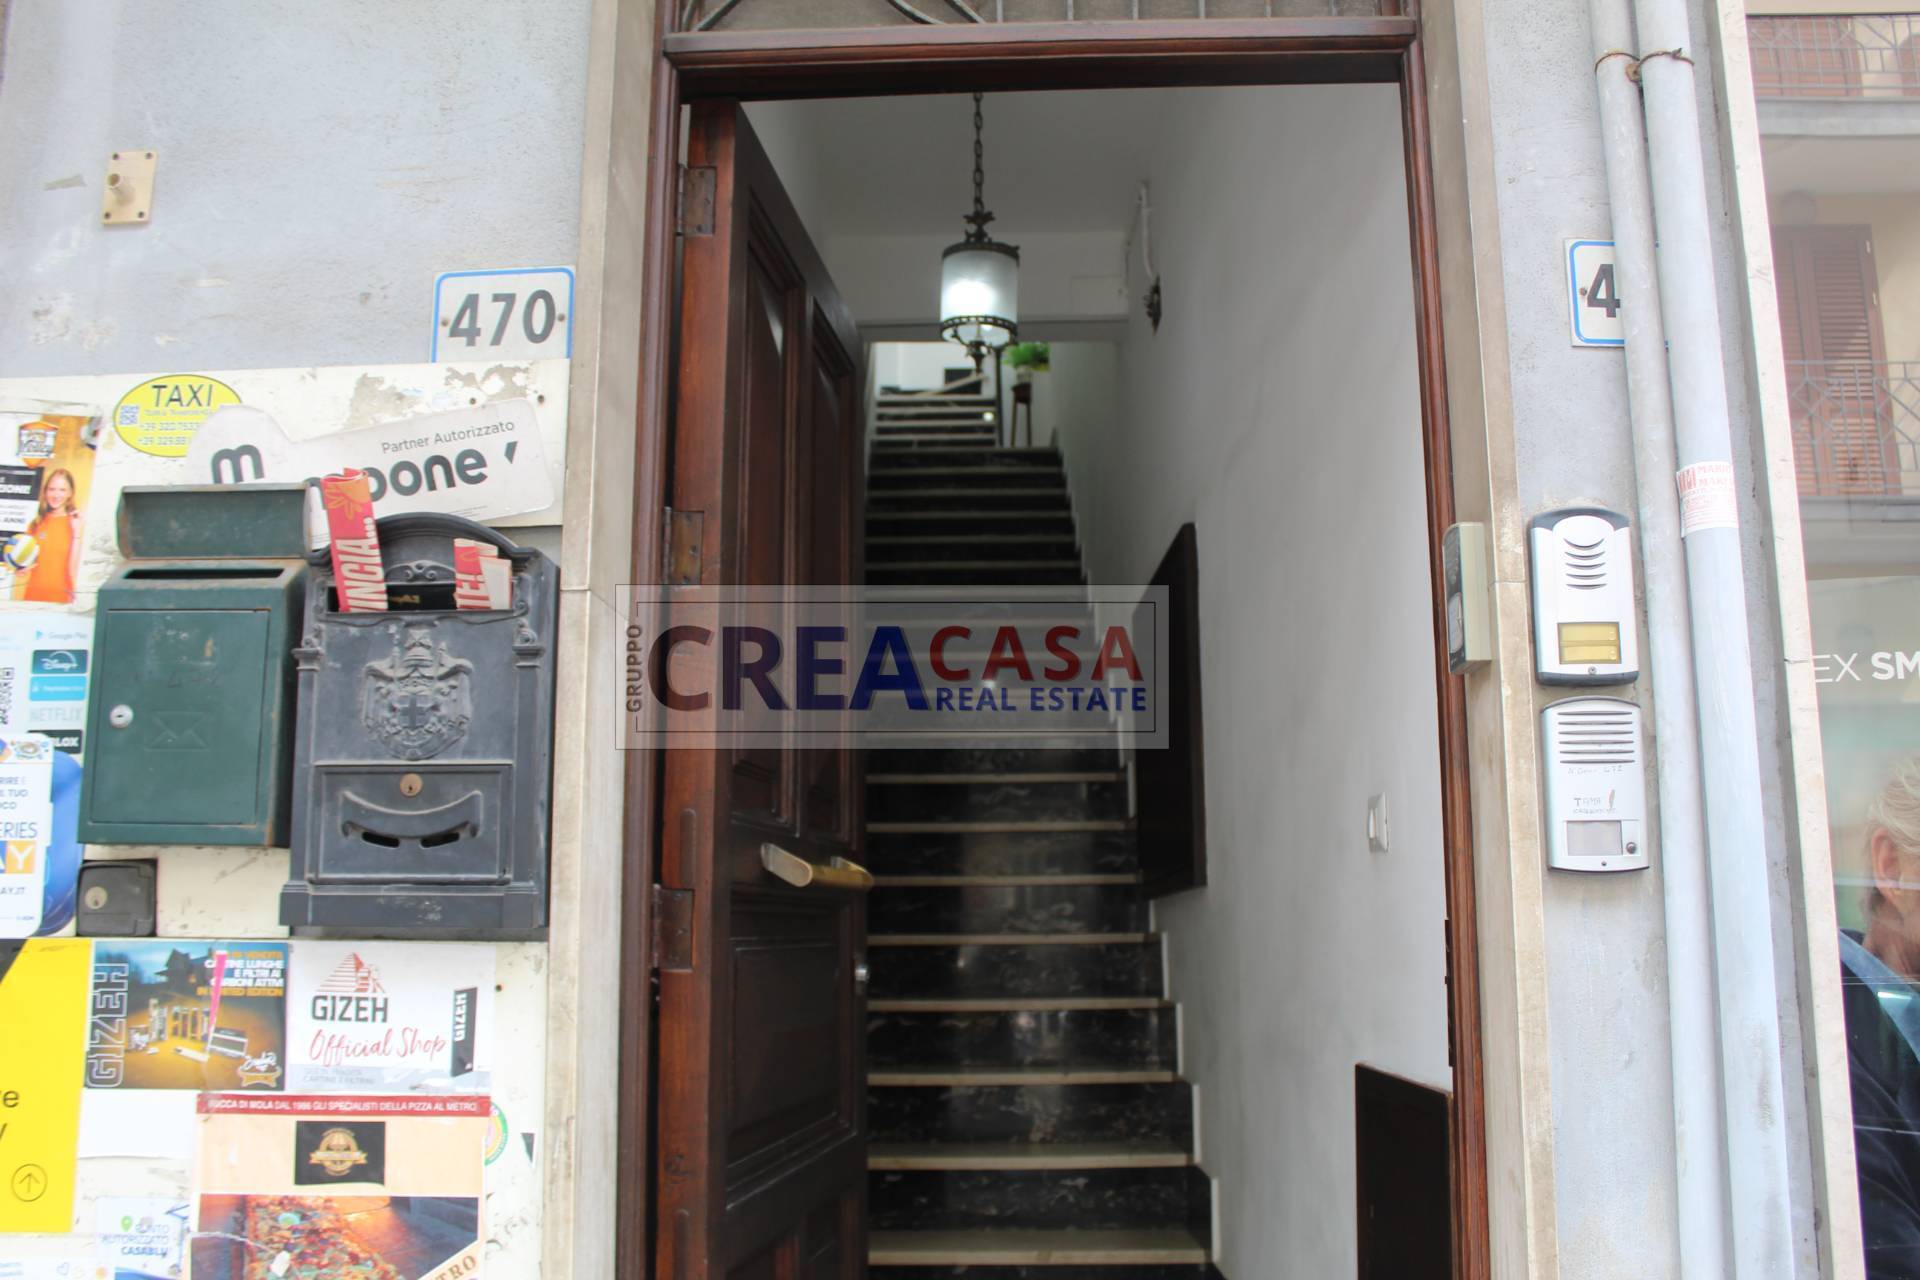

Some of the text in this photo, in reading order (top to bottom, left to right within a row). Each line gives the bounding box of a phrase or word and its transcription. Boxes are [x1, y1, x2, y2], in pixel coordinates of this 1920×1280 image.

[448, 290, 556, 347] 470
[152, 384, 213, 407] TAXI
[381, 420, 516, 455] Partner Autorizzato
[86, 962, 129, 1088] GIZEH
[311, 994, 389, 1023] GIZEH
[453, 992, 468, 1042] GIZEH
[308, 1027, 394, 1068] Official
[396, 1026, 447, 1061] Shop
[328, 1101, 379, 1110] SPECIALISTI
[380, 1101, 408, 1111] DELLA
[408, 1101, 433, 1111] PIZZA
[433, 1102, 446, 1111] AL
[447, 1102, 477, 1112] METRO
